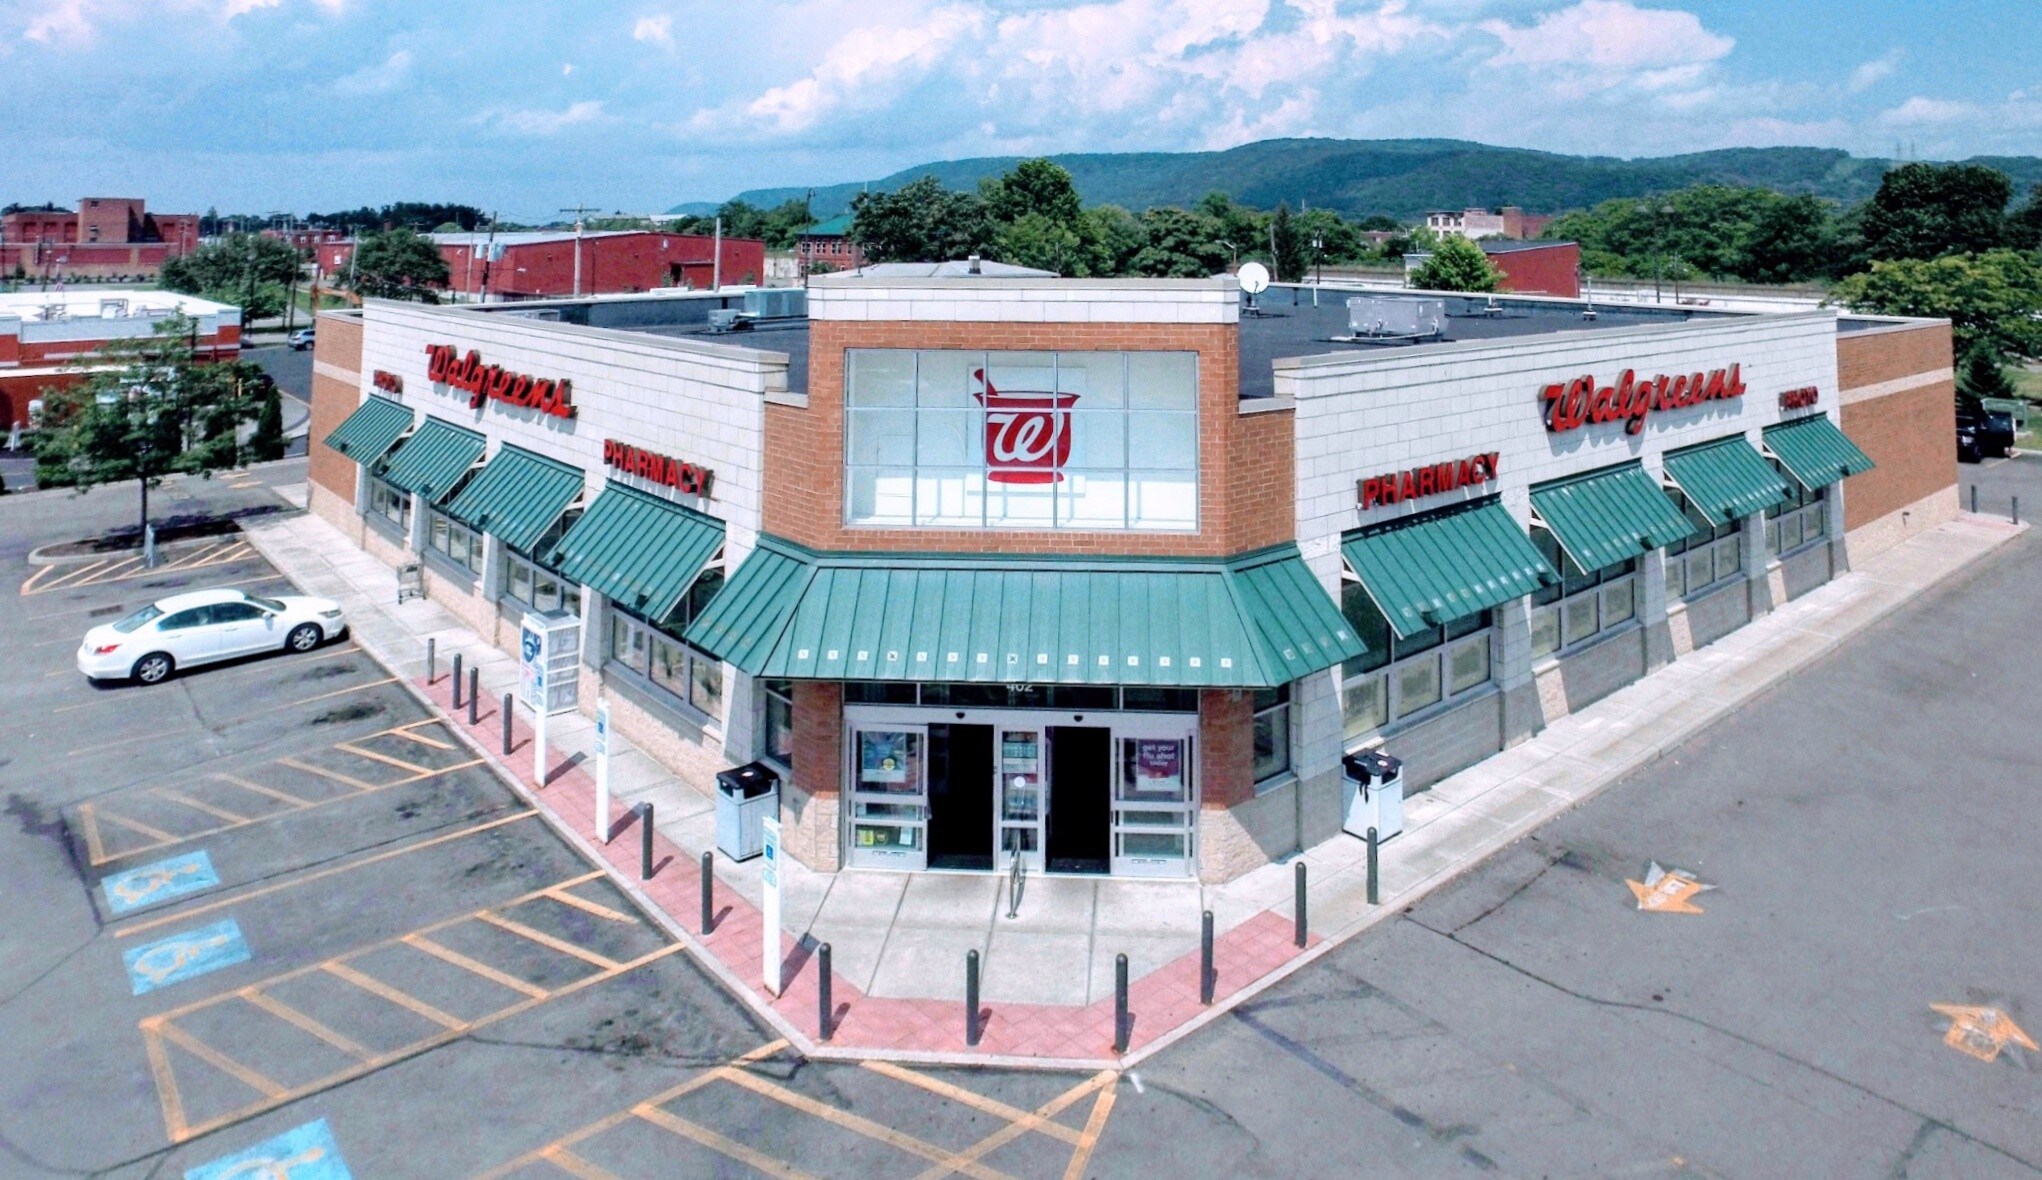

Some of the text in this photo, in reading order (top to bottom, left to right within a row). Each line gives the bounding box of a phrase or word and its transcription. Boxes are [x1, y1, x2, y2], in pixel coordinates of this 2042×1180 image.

[425, 343, 576, 419] Walgreens
[1539, 362, 1747, 436] Walgreens
[603, 438, 713, 499] PHARMACY
[1358, 451, 1500, 511] PHARMACY
[1142, 744, 1175, 753] get your
[1142, 752, 1175, 760] flu shot
